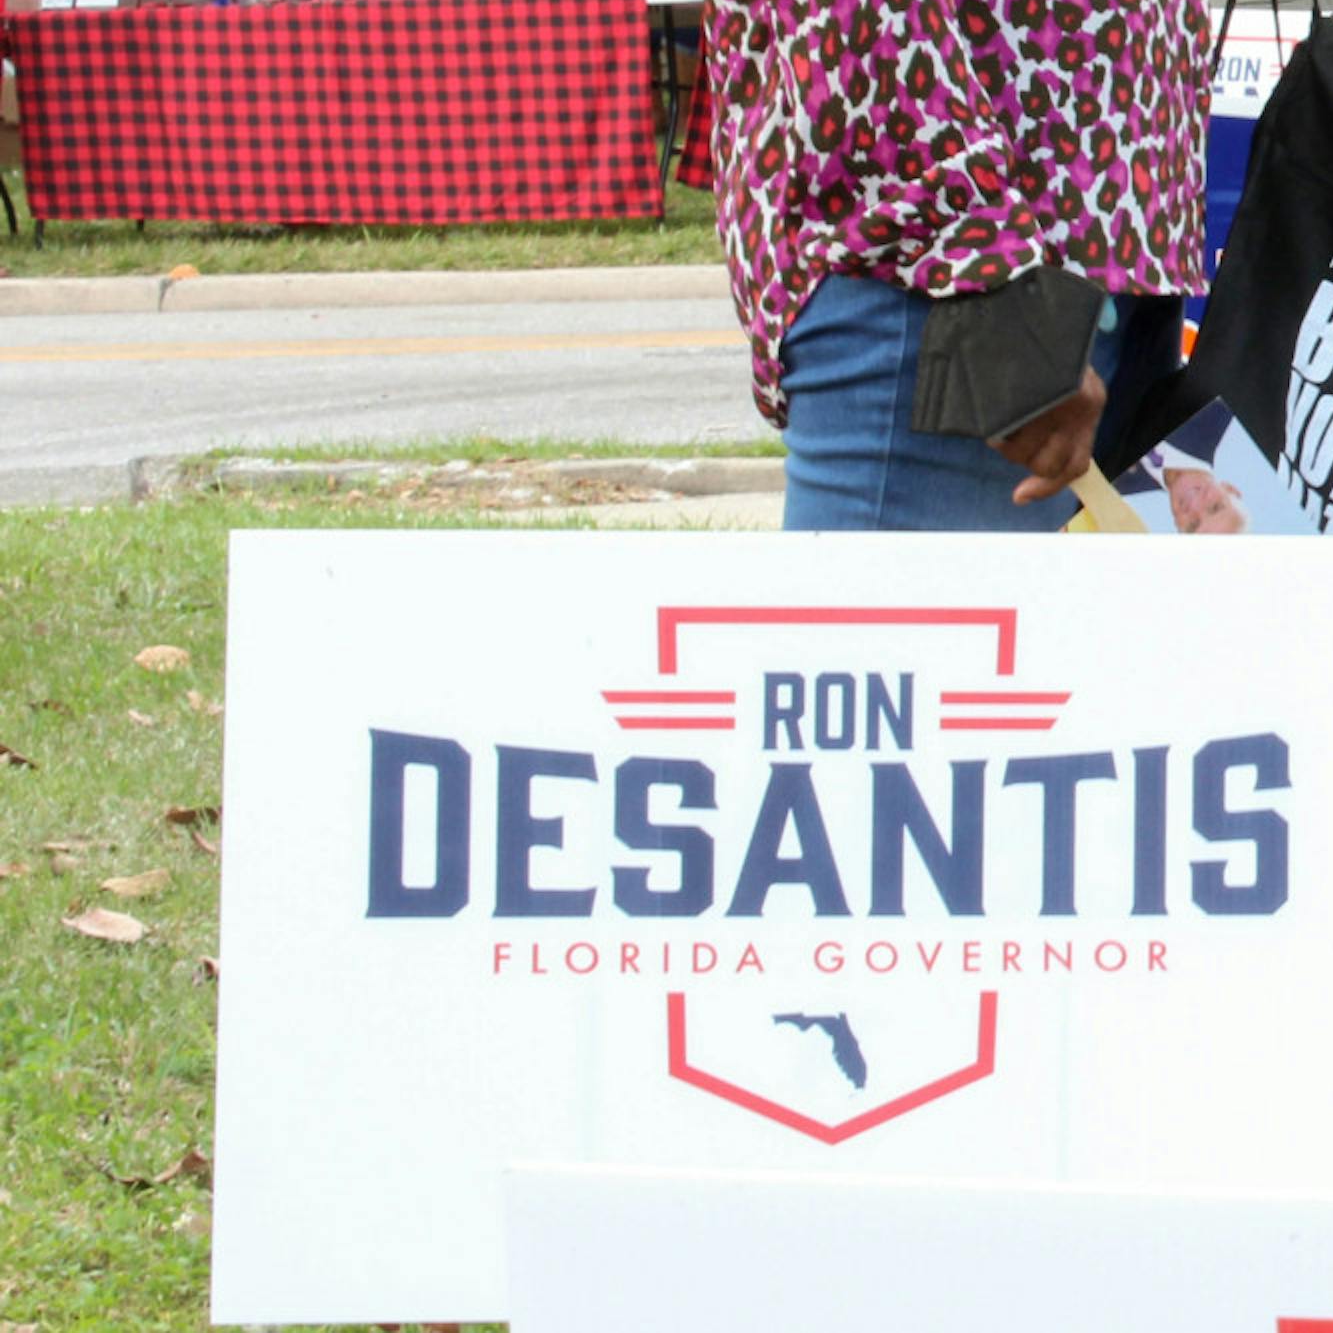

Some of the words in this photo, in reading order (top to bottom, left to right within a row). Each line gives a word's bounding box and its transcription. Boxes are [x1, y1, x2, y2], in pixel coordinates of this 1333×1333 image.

[761, 672, 914, 751] RON
[365, 727, 1292, 918] DESANTIS
[492, 941, 766, 975] FLORIDA
[813, 939, 1170, 974] GOVERNOR
